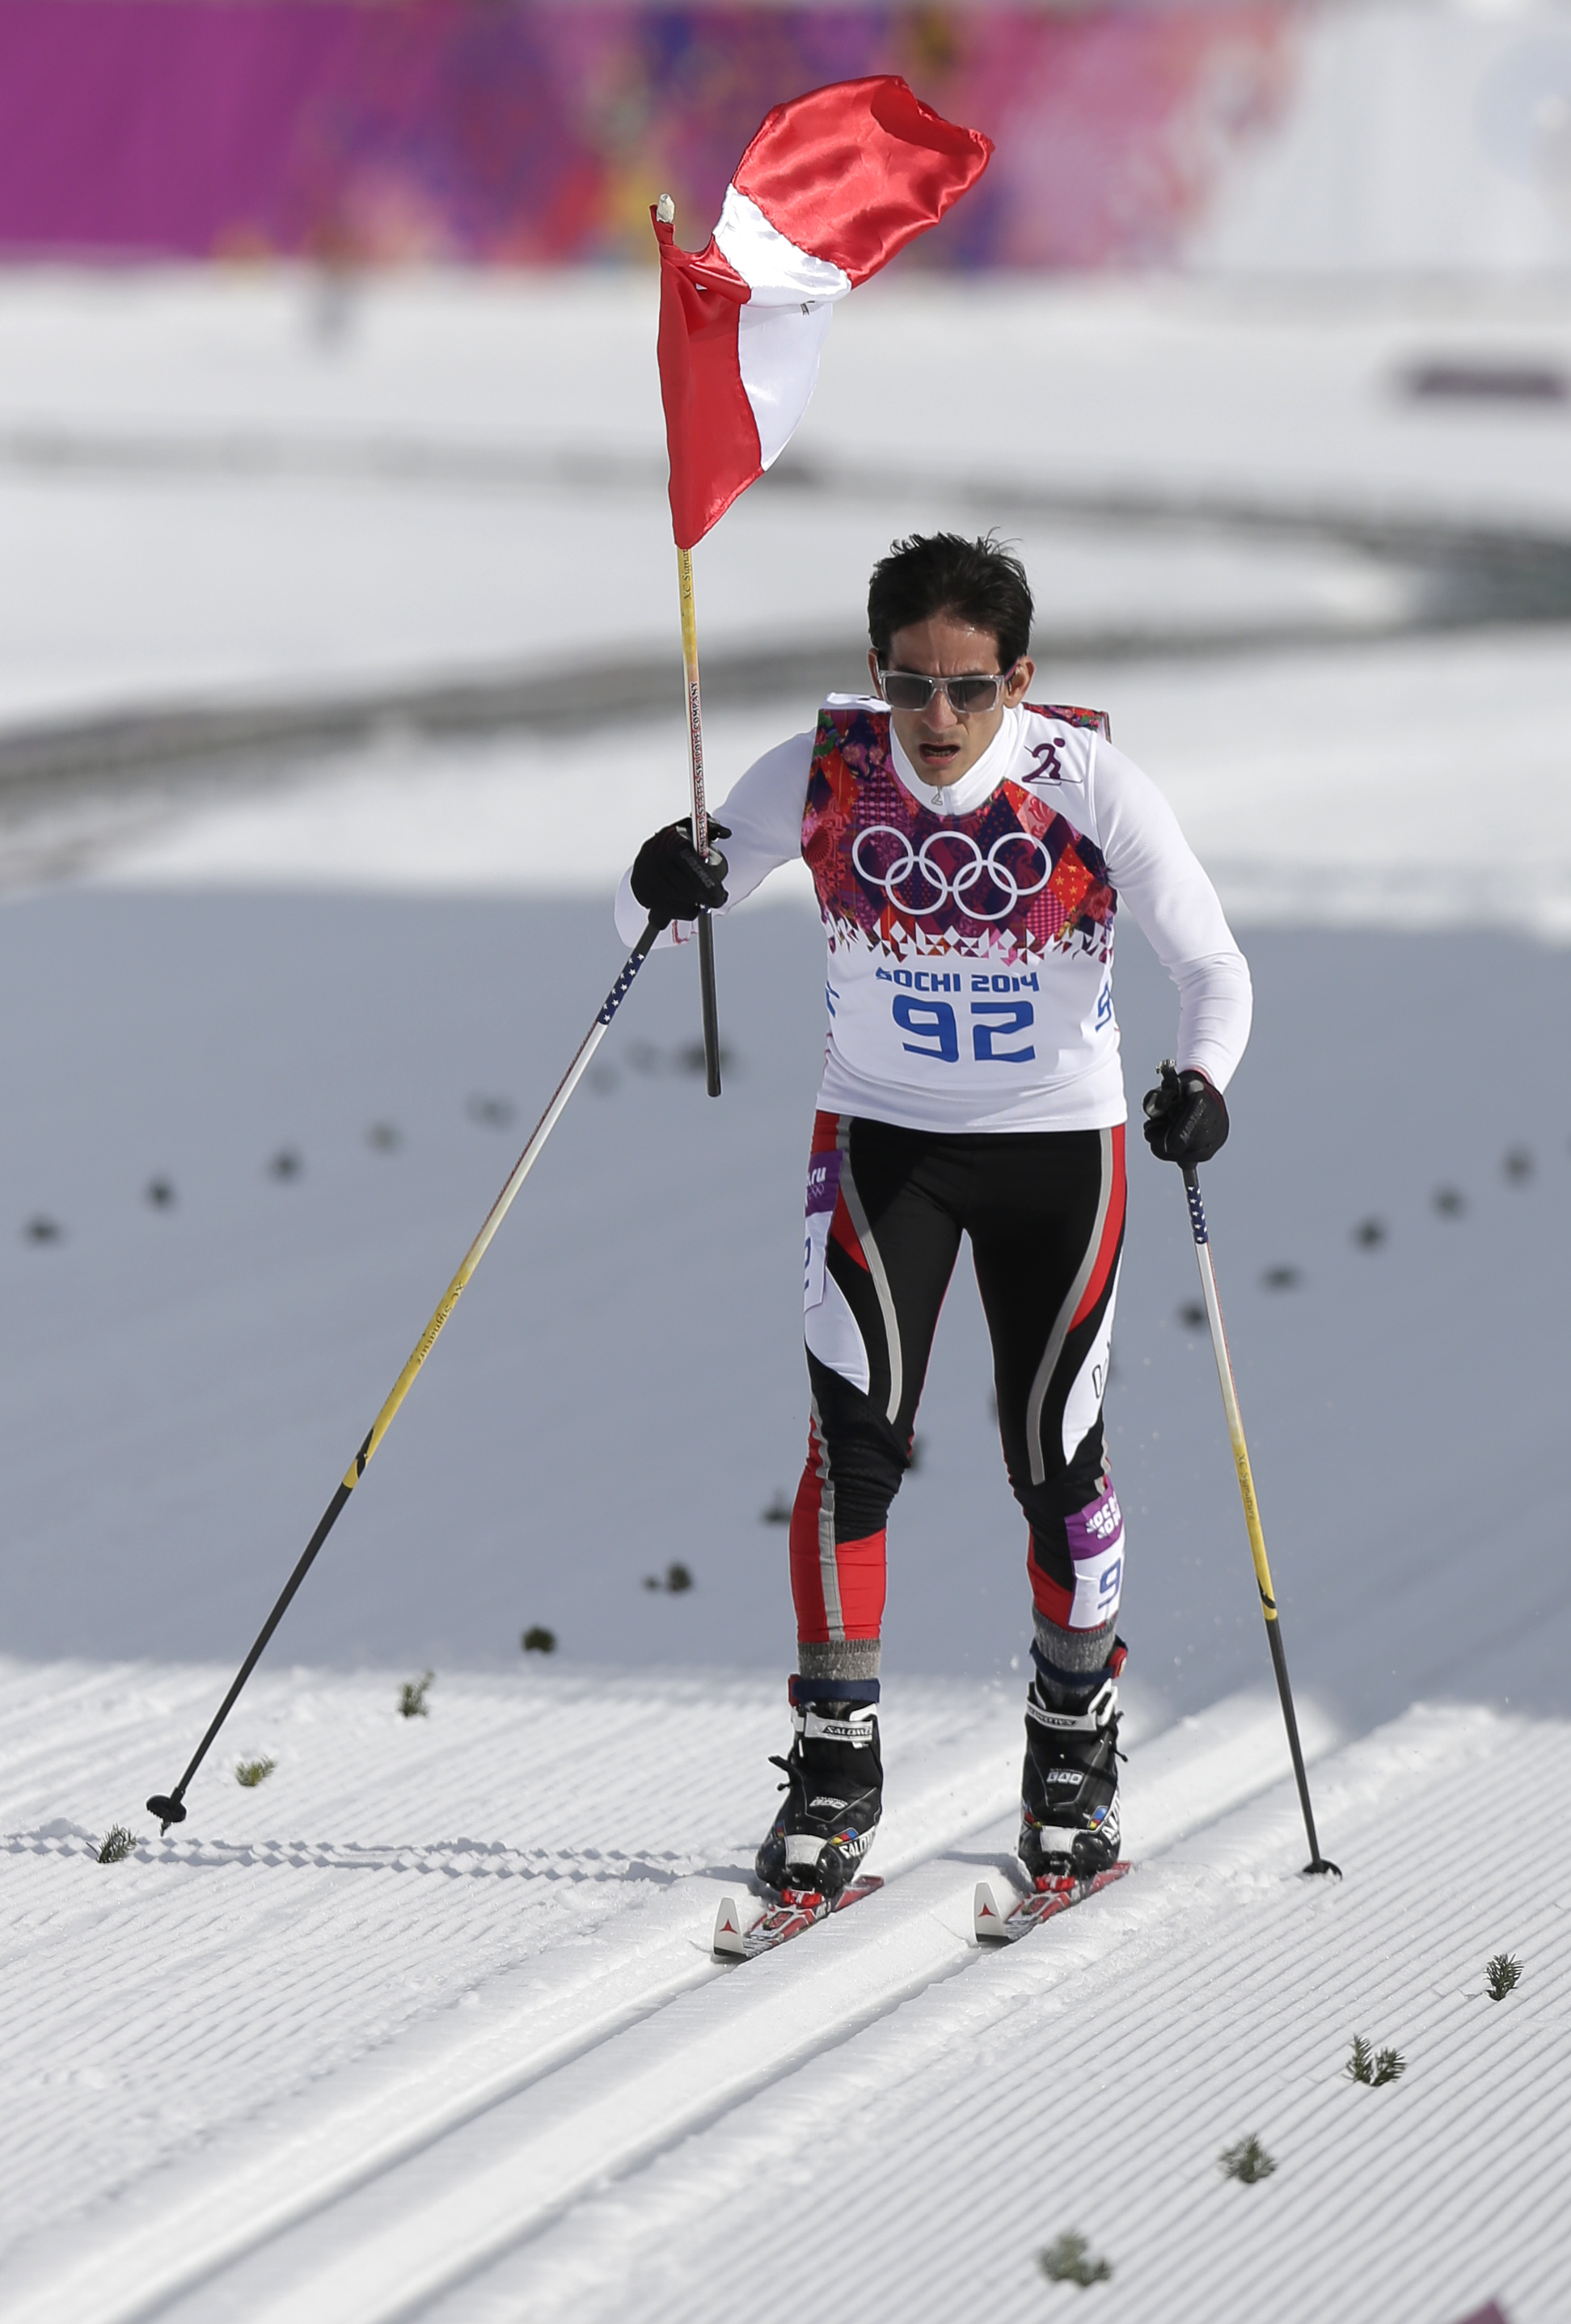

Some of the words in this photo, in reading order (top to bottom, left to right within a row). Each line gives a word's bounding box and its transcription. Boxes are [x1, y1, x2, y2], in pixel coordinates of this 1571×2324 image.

[682, 549, 691, 580] Signat
[682, 584, 692, 600] XC
[690, 682, 700, 730] COMPANY
[696, 778, 705, 816] STATES
[876, 967, 961, 992] SOCHI
[971, 972, 1040, 993] 2014
[892, 994, 1036, 1063] 92
[417, 1305, 452, 1364] Signature
[1097, 1558, 1121, 1610] 9
